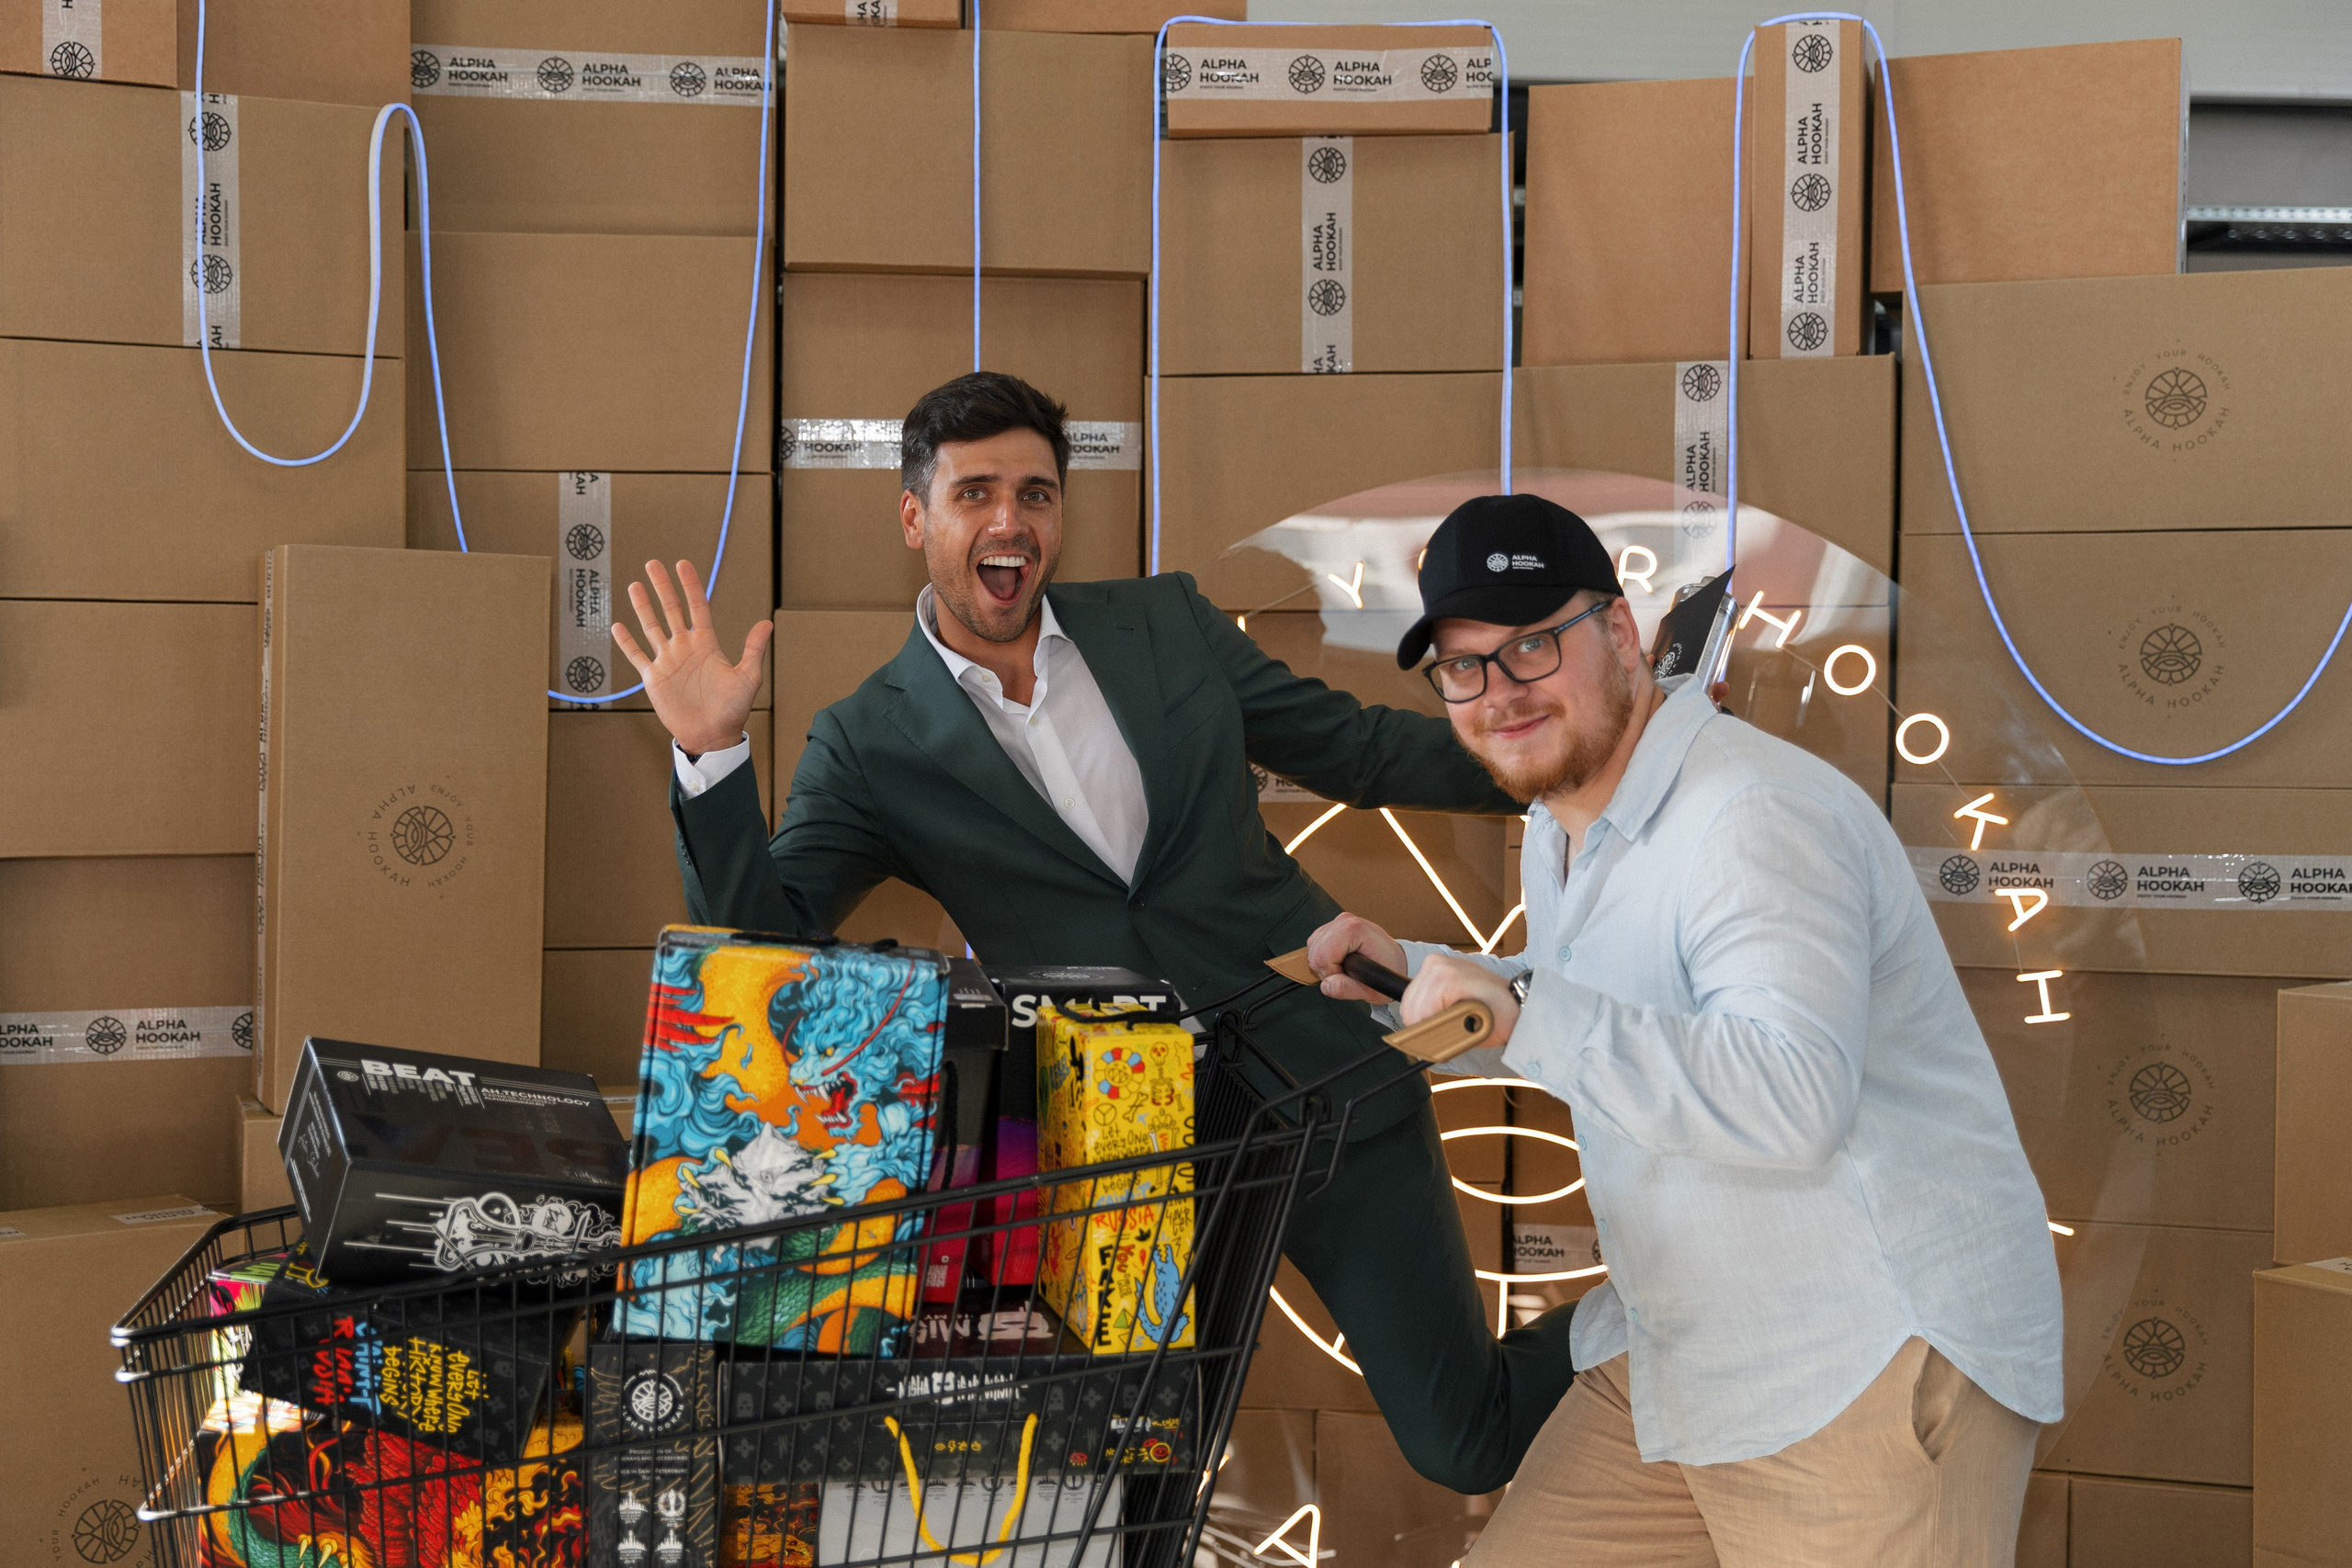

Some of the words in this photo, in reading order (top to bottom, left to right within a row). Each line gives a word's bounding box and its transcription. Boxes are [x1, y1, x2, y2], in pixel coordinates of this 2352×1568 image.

[448, 57, 495, 69] ALPHA
[582, 62, 628, 75] ALPHA
[715, 66, 761, 78] ALPHA
[1201, 59, 1247, 70] ALPHA
[1334, 61, 1381, 72] ALPHA
[1466, 59, 1491, 68] ALP
[448, 70, 508, 83] HOOKAH
[582, 75, 641, 87] HOOKAH
[1200, 72, 1260, 83] HOOKAH
[1333, 74, 1392, 85] HOOKAH
[1797, 116, 1808, 164] ALPHA
[1811, 103, 1822, 164] HOOKAH
[210, 183, 221, 246] HOOKAH
[1313, 224, 1323, 271] ALPHA
[1327, 212, 1336, 271] HOOKAH
[1793, 255, 1805, 304] ALPHA
[1807, 242, 1819, 304] HOOKAH
[2123, 409, 2159, 448] ALPHA
[2173, 406, 2230, 452] HOOKAH
[1072, 444, 1120, 454] OOKAH
[1686, 445, 1696, 492] ALPHA
[1700, 431, 1710, 492] HOOKAH
[576, 569, 585, 627] HOOKAH
[589, 569, 599, 615] ALPHA
[2118, 663, 2154, 705] ALPHA
[2167, 664, 2224, 708] HOOKAH
[372, 784, 415, 819] ALPHA
[368, 831, 411, 887] HOOKAH
[1989, 862, 2041, 874] ALPHA
[1988, 875, 2054, 888] HOOKAH
[2138, 866, 2190, 878] ALPHA
[2291, 868, 2346, 879] ALPHA
[2137, 880, 2205, 893] HOOKAH
[0, 1024, 39, 1035] LPHA
[137, 1020, 187, 1030] ALPHA
[0, 1036, 53, 1047] OOKAH
[136, 1032, 201, 1043] HOOKAH
[361, 1059, 476, 1086] BEAT
[481, 1088, 591, 1107] AH.TECHNOLOGY
[2108, 1099, 2143, 1142] ALPHA
[2156, 1104, 2213, 1146] HOOKAH
[2103, 1353, 2138, 1397] ALPHA
[2150, 1361, 2207, 1402] HOOKAH
[58, 1477, 99, 1517] HOOKAH
[51, 1529, 62, 1562] YOUR
